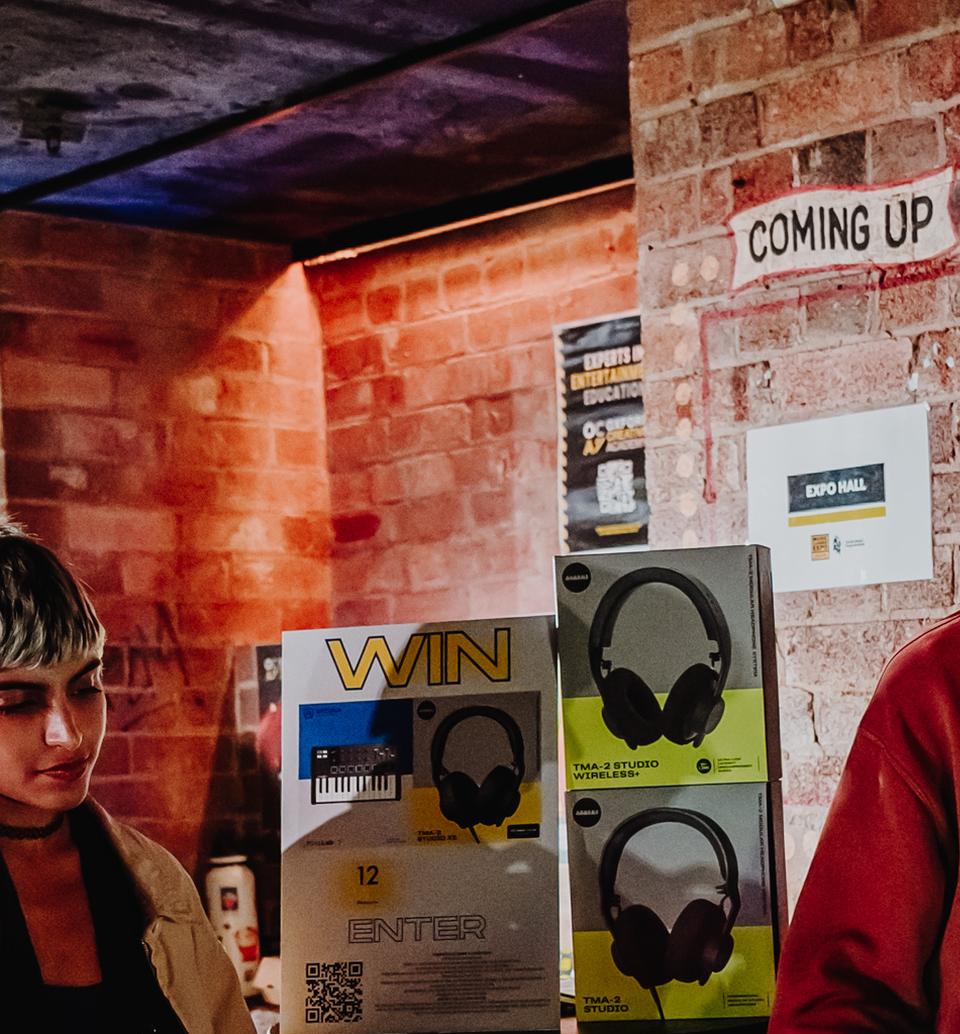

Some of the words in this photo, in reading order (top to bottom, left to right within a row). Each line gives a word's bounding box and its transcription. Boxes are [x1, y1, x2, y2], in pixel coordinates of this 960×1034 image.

[749, 204, 870, 263] COMING
[885, 195, 933, 248] UP
[583, 346, 631, 371] EXPERTS
[805, 482, 837, 499] EXPO
[838, 478, 867, 494] HALL
[325, 627, 512, 691] WIN
[573, 761, 611, 772] TMA-2
[614, 760, 659, 769] STUDIO
[573, 770, 640, 781] WIRELESS+
[357, 865, 379, 886] 12
[348, 914, 487, 944] ENTER
[583, 995, 621, 1005] TMA-2
[583, 1004, 629, 1014] STUDIO
